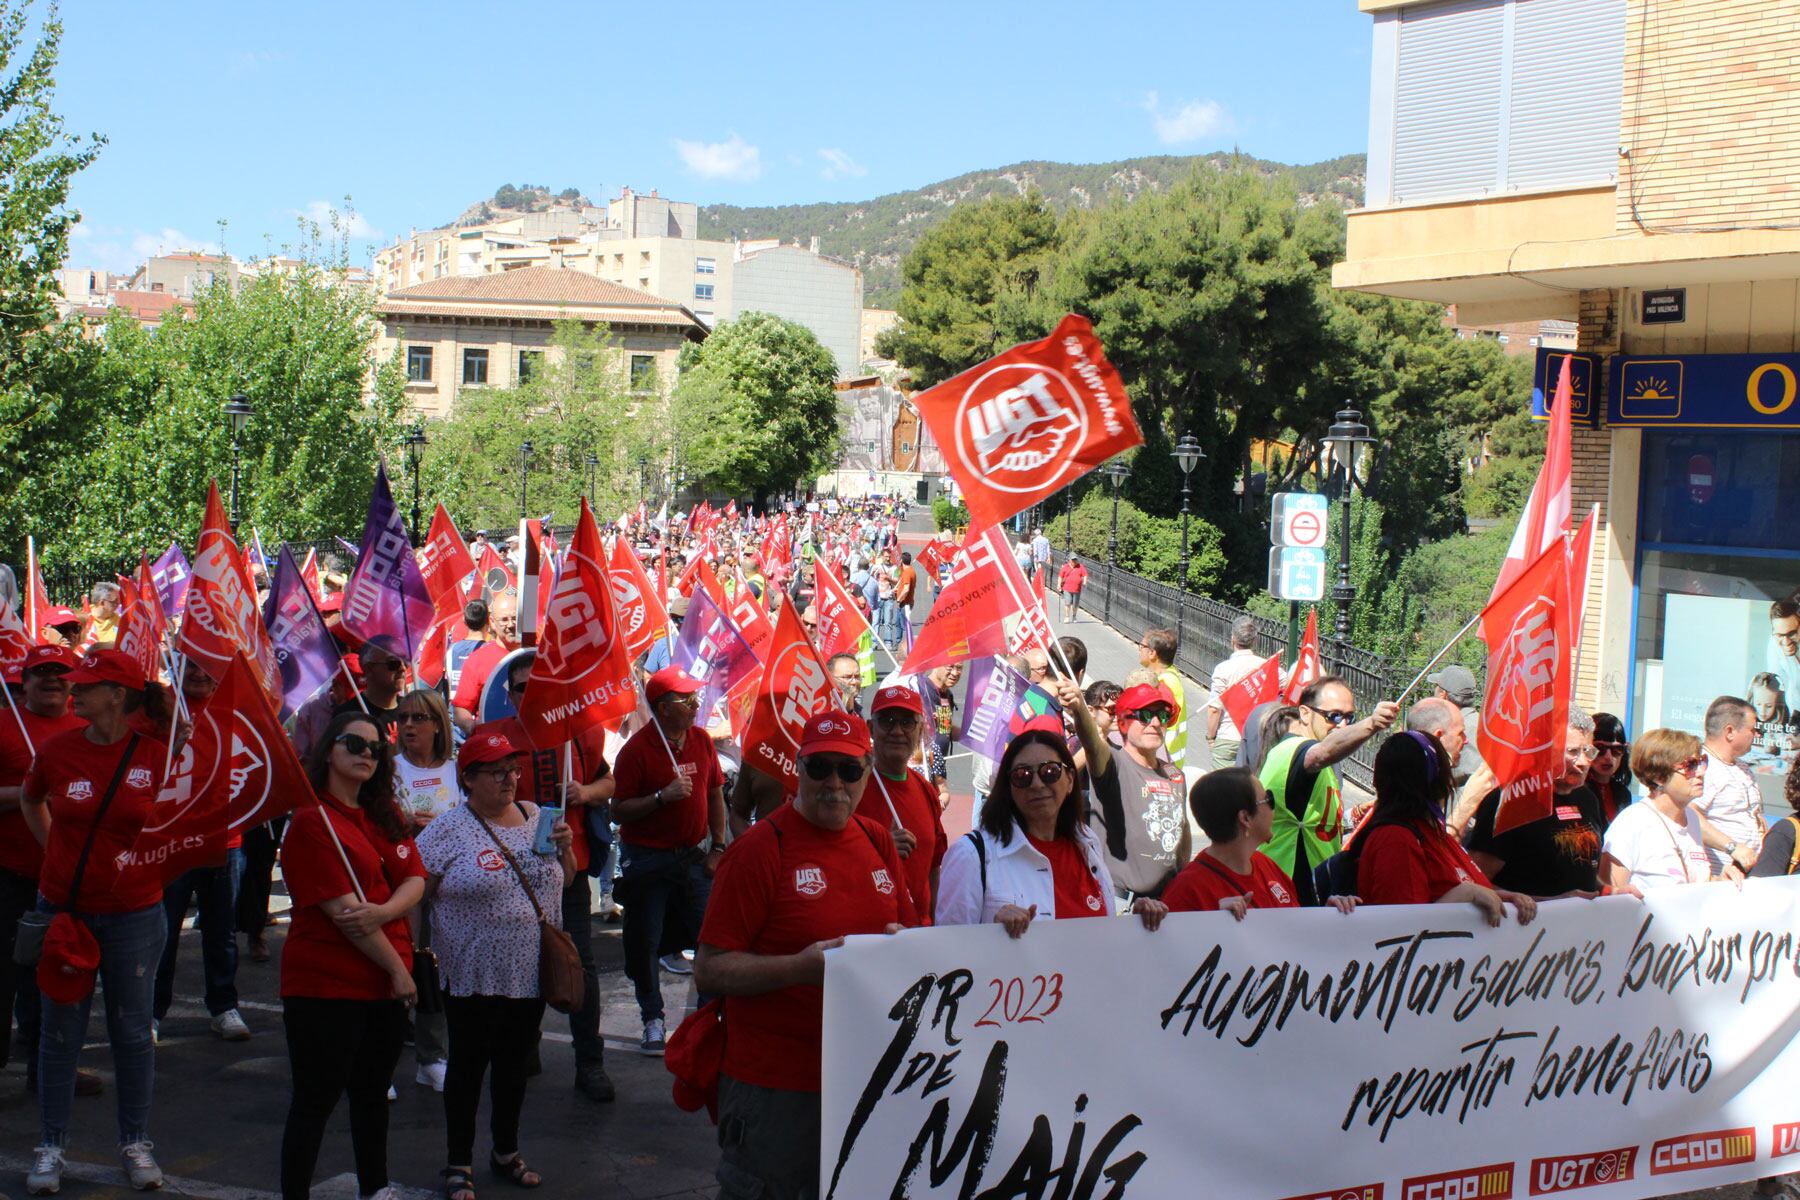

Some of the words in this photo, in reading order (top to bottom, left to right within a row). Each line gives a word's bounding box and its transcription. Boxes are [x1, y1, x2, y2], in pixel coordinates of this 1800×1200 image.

[967, 373, 1063, 441] UGT
[192, 538, 254, 652] UGT
[550, 561, 608, 659] UGT
[68, 781, 92, 794] UGT
[129, 769, 151, 782] UGT
[479, 853, 499, 865] UGT
[796, 868, 821, 884] UGT
[871, 869, 888, 883] UGT
[1617, 912, 1742, 998] baixar
[973, 973, 1064, 1028] 2023
[891, 1049, 962, 1099] DE
[1341, 1027, 1538, 1143] repartir
[1525, 1025, 1713, 1106] beneficis
[1655, 1138, 1723, 1168] CCOO
[1780, 1126, 1800, 1150] U
[1538, 1157, 1596, 1192] UGT
